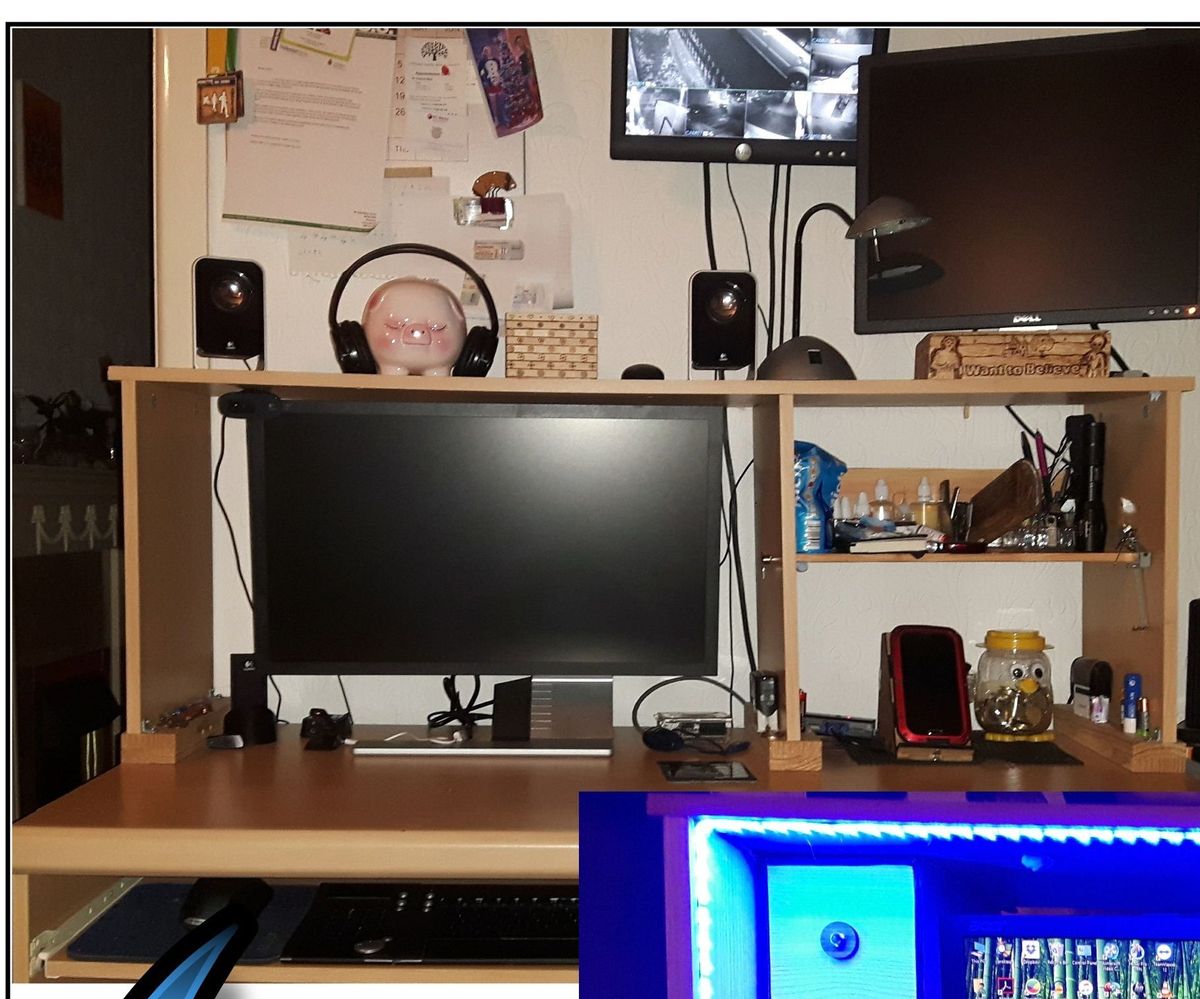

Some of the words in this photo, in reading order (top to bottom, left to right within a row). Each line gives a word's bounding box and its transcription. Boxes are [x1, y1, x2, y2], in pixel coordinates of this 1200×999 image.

[395, 76, 405, 84] 12
[395, 92, 405, 100] 19
[966, 363, 1004, 376] Want
[1005, 364, 1023, 376] to
[1025, 362, 1081, 376] Believe
